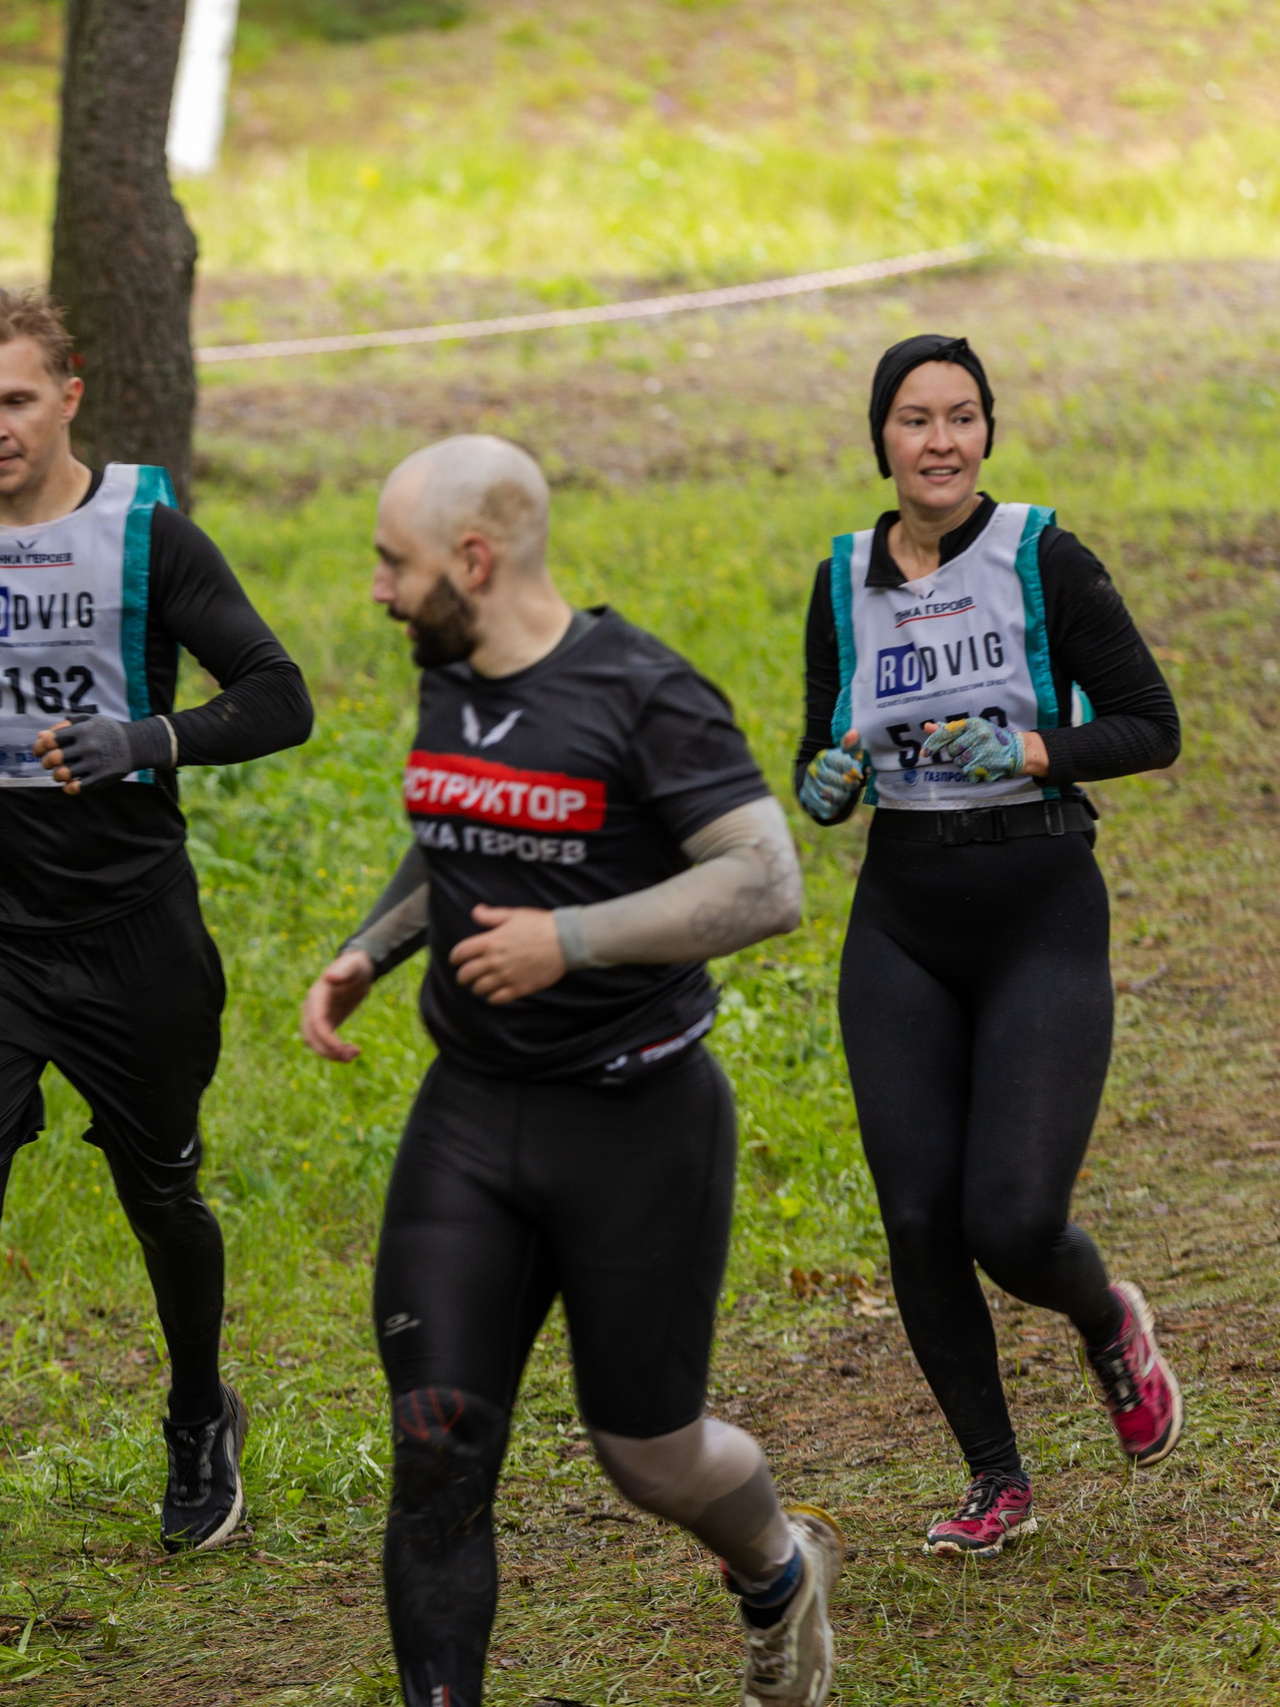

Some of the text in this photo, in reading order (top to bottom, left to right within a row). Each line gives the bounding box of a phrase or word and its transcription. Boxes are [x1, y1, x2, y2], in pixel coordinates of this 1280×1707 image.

[26, 552, 73, 564] ГЕРОЕВ
[925, 596, 974, 615] ГЕРОЕВ
[879, 631, 1005, 692] RODVIG
[463, 826, 588, 866] ГЕРОЕВ
